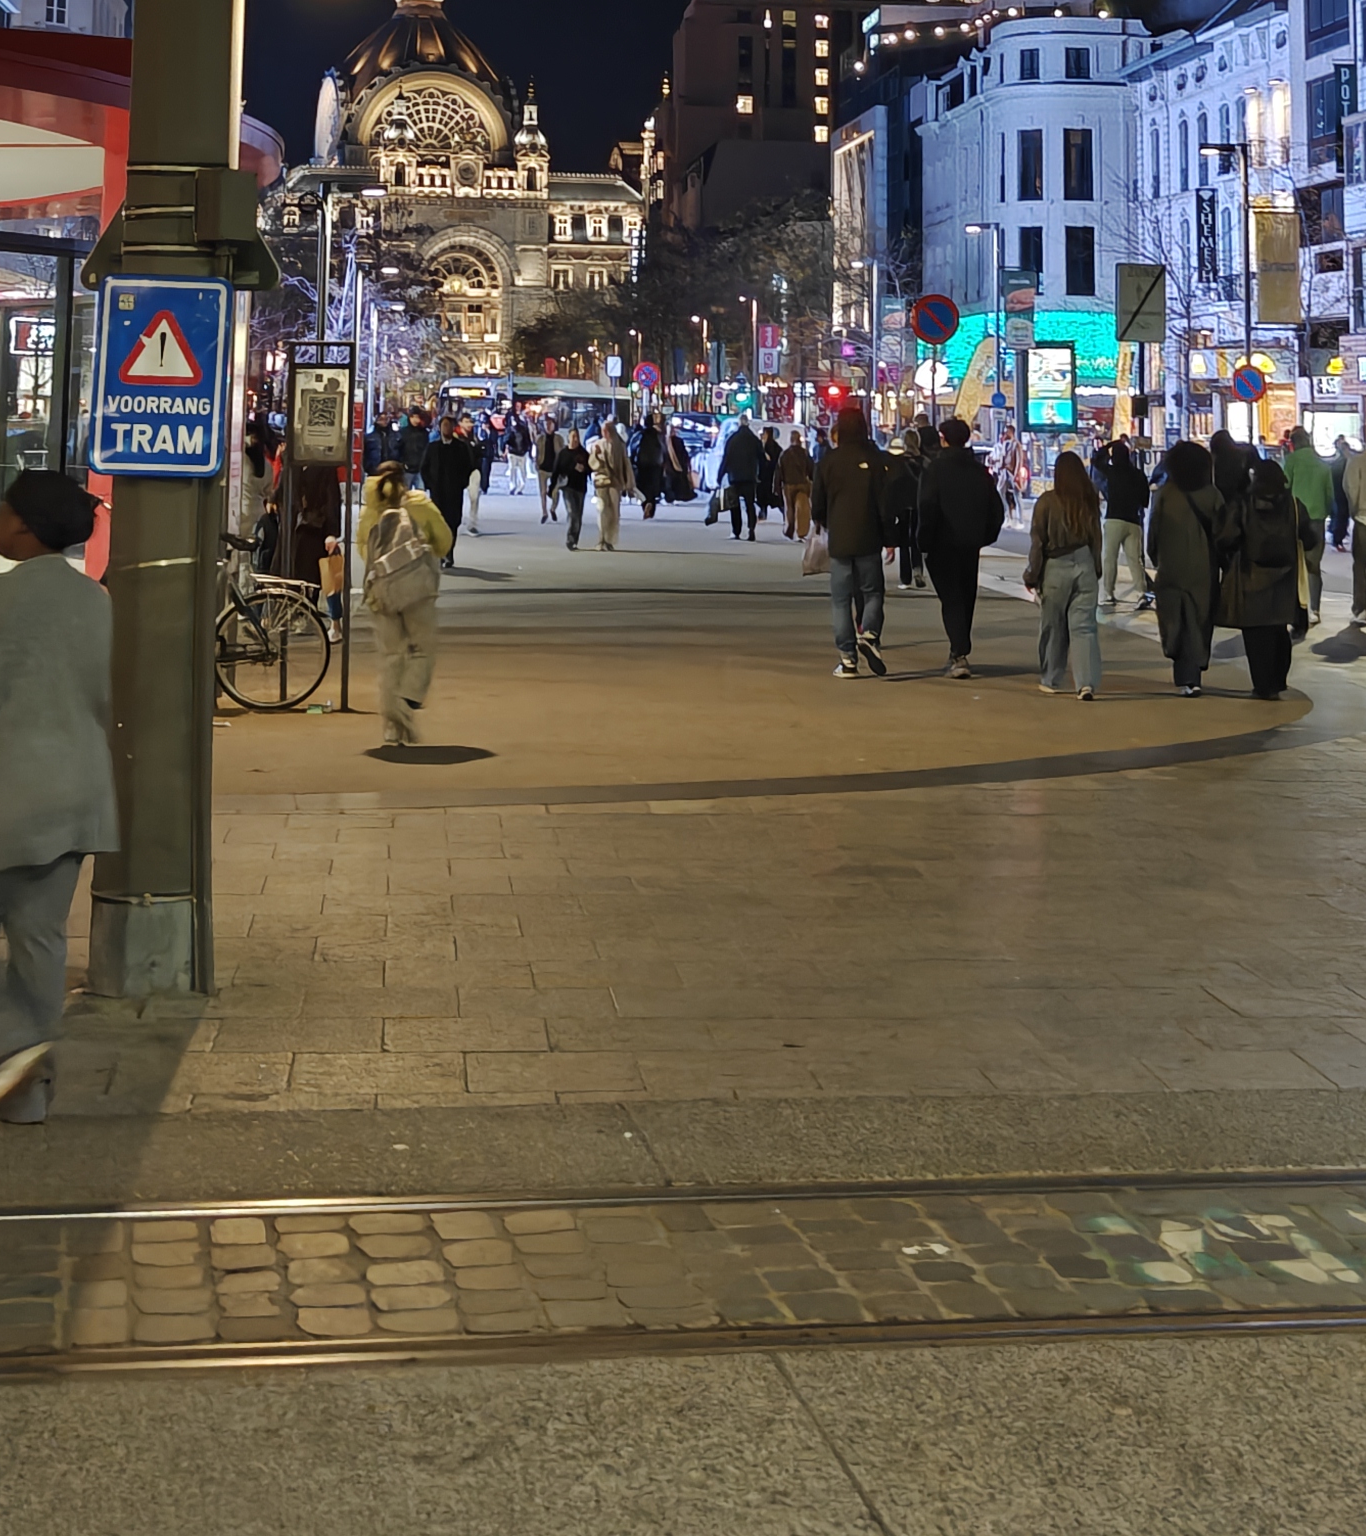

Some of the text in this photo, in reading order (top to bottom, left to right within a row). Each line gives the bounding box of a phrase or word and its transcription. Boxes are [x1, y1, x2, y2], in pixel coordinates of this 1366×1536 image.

[1199, 201, 1215, 283] SHEMESH
[106, 395, 212, 416] VOORRANG
[110, 423, 204, 455] TRAM
